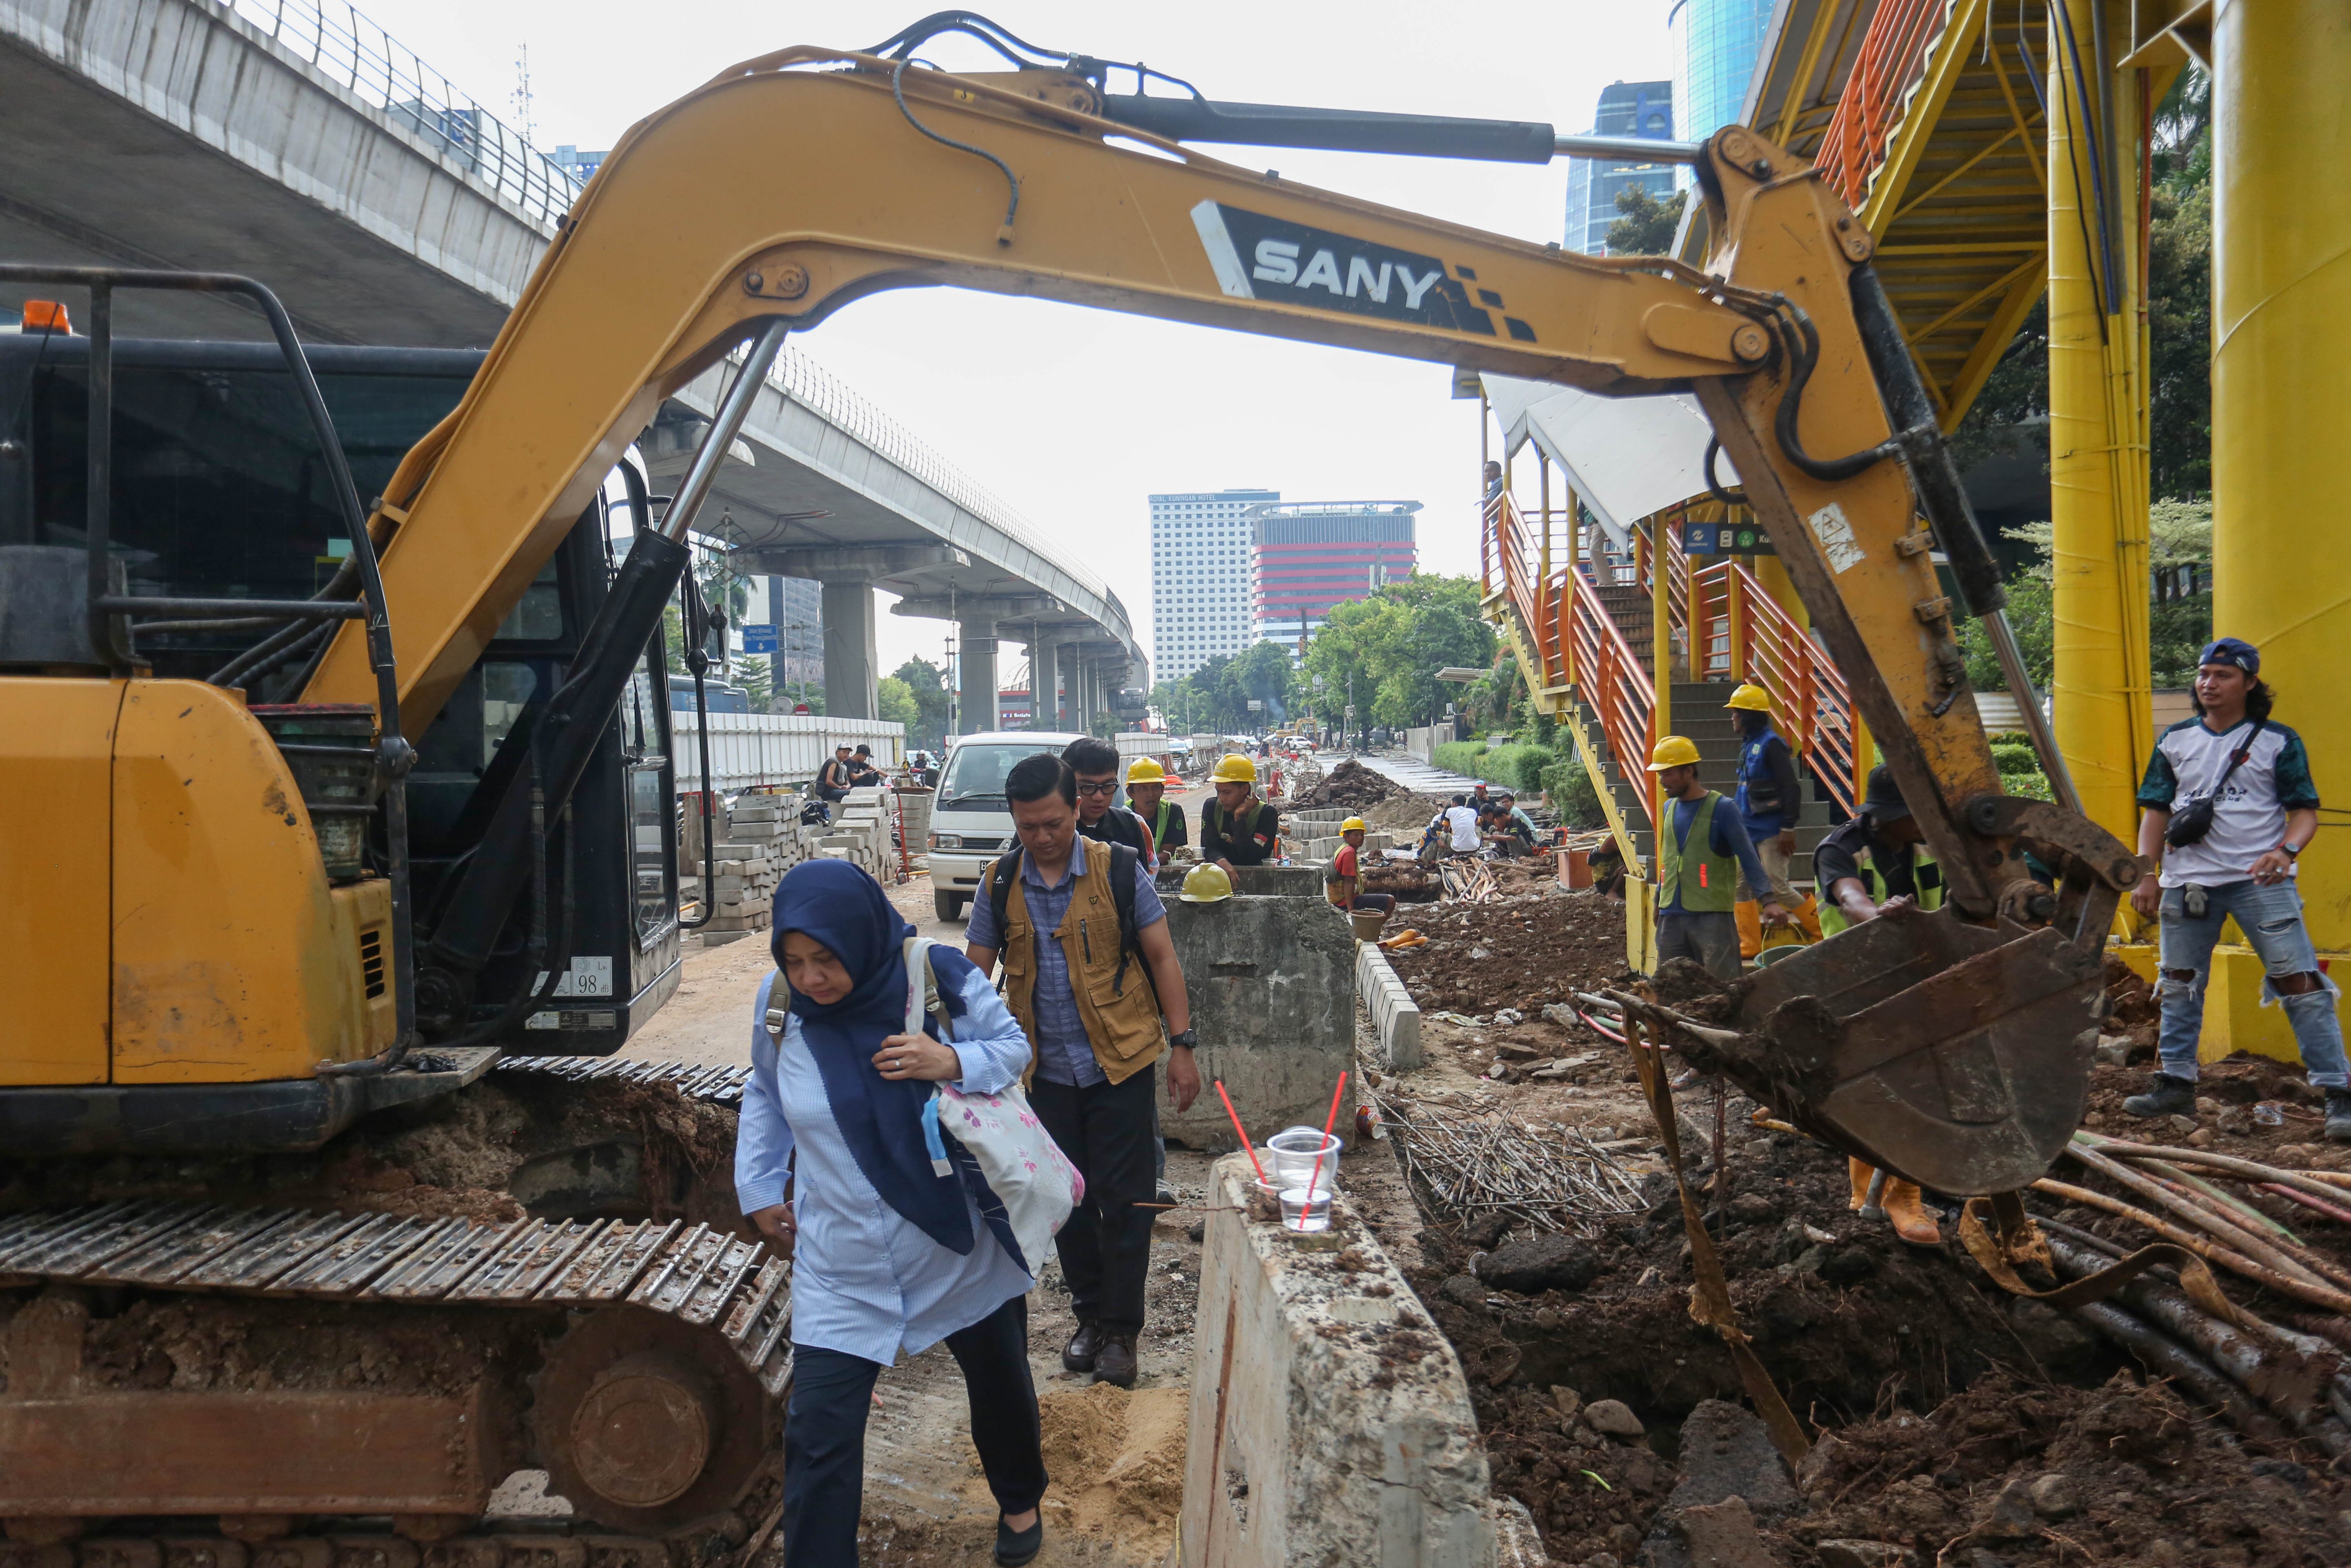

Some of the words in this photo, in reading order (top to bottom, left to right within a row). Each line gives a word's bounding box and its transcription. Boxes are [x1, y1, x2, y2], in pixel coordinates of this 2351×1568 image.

[1252, 239, 1442, 310] SANY
[981, 862, 987, 871] B
[579, 975, 596, 993] 98
[601, 984, 608, 993] dB
